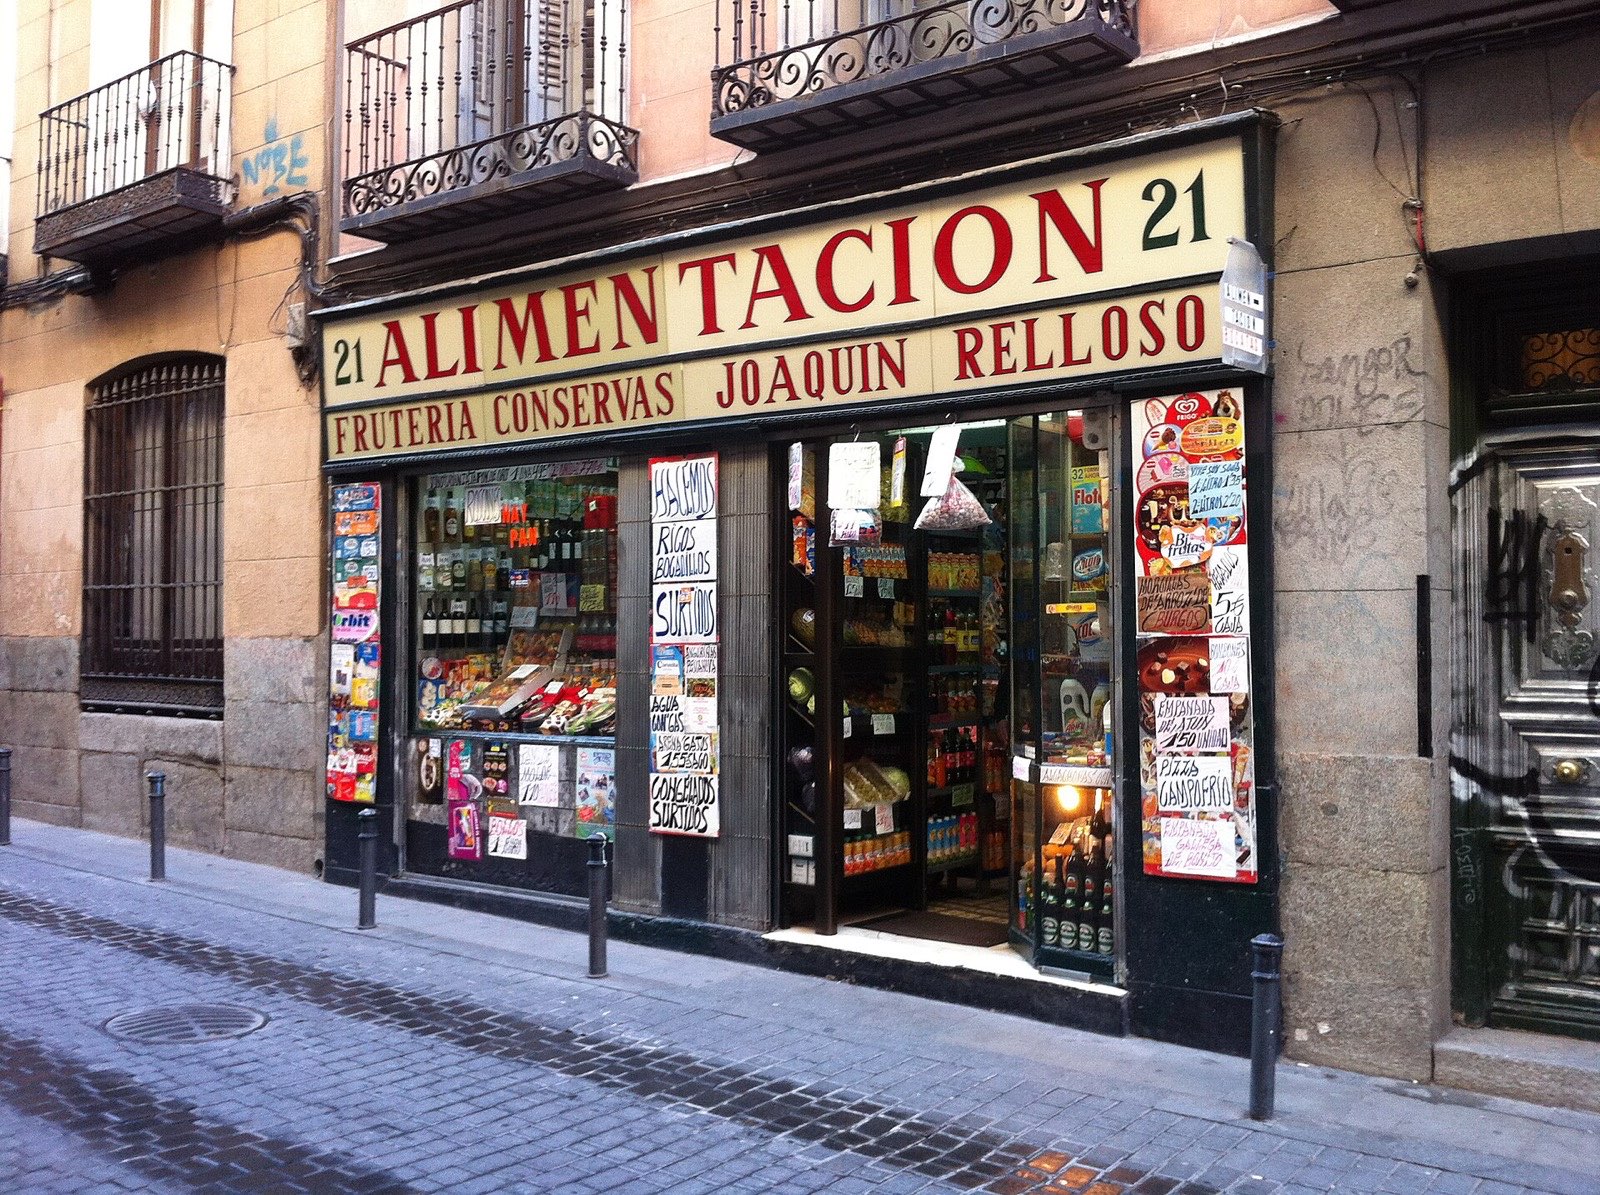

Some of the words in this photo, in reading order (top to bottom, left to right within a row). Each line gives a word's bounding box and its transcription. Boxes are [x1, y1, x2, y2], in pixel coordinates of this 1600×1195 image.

[334, 338, 363, 386] 21
[374, 177, 1109, 388] ALIMENTACION
[1141, 168, 1211, 251] 21
[335, 400, 477, 454] FRUTERIA
[493, 372, 675, 435] CONSERVAS
[716, 337, 908, 409] JOAQUIN
[953, 295, 1205, 381] RELLOSO
[1071, 469, 1084, 480] 32
[652, 461, 715, 520] HACEMOS
[510, 527, 538, 549] PAN
[656, 524, 696, 556] RICOS
[1168, 542, 1205, 557] frutas
[332, 614, 370, 627] Orbit
[651, 695, 679, 712] AGUA
[1157, 699, 1215, 718] EMPANADA
[1160, 759, 1198, 777] PIZZA
[652, 775, 715, 806] CONGELADOS
[652, 801, 709, 833] SURTIDOS
